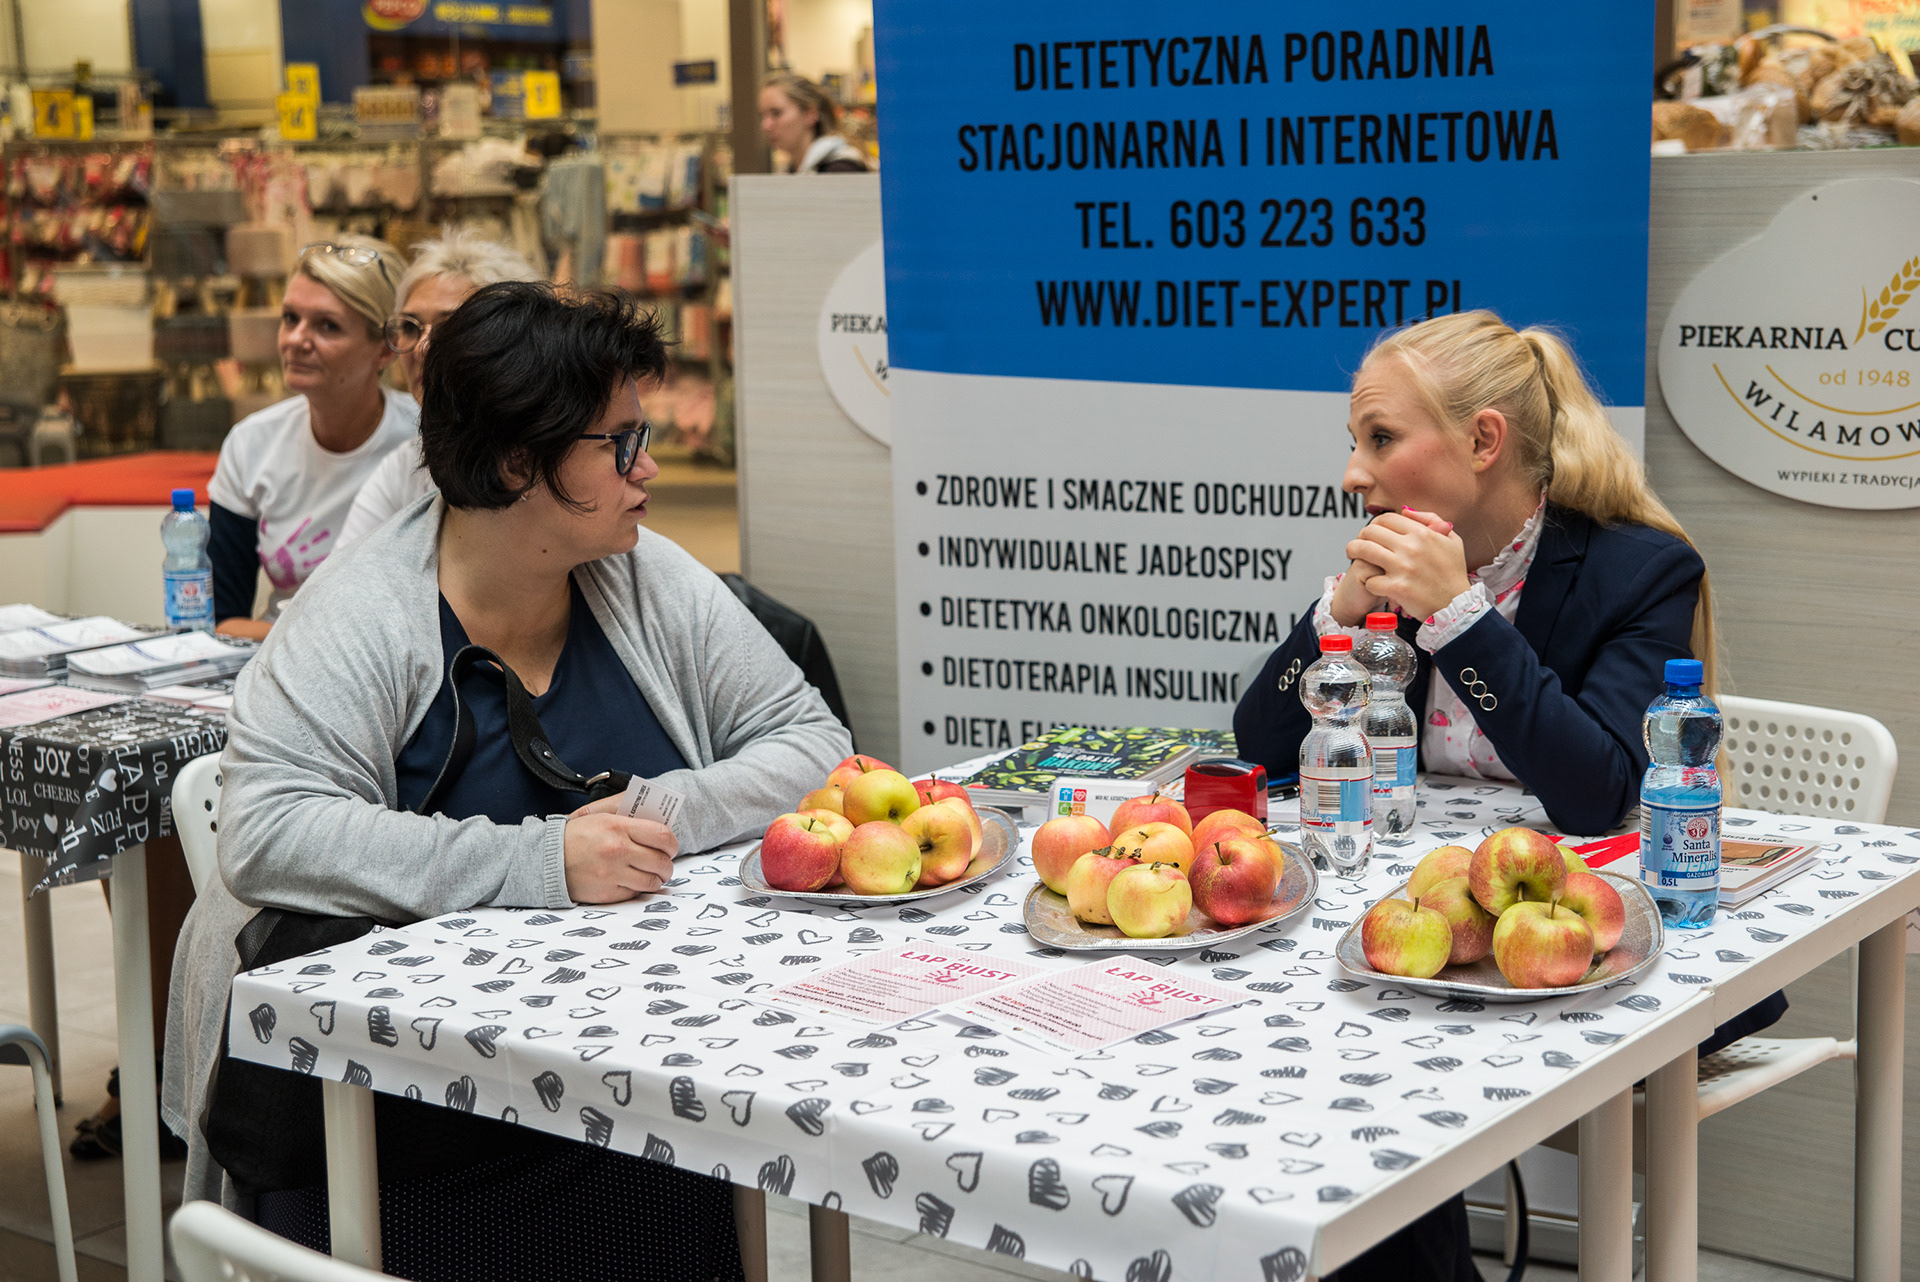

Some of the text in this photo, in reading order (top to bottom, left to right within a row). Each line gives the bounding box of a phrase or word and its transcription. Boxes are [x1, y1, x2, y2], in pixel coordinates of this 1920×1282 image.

[1013, 24, 1495, 91] DIETETYCZNA PORADNIA
[957, 108, 1560, 173] STACJONARNA I INTERNETOWA
[1074, 196, 1427, 249] TEL. 603 223 633
[1679, 325, 1848, 350] PIEKARNIA
[1819, 369, 1911, 388] od 1948
[1744, 380, 1920, 446] WILAMOW
[936, 474, 1038, 509] ZDROWE
[1047, 478, 1055, 509] I
[1063, 478, 1184, 514] SMACZNE
[1777, 470, 1836, 484] WYPIEKI
[1839, 473, 1849, 485] Z
[938, 535, 1292, 581] INDYWIDUALNE JADŁOSPISY
[940, 596, 1072, 633] DIETETYKA
[1081, 603, 1279, 643] ONKOLOGICZNA
[942, 655, 1117, 697] DIETOTERAPIA
[944, 715, 1011, 749] DIETA
[33, 745, 71, 778] JOY
[152, 750, 169, 787] LOL
[5, 786, 32, 807] LOL
[33, 781, 81, 805] CHEERS
[11, 808, 40, 839] Joy
[89, 807, 123, 837] FUN
[159, 794, 172, 838] SMILE
[1672, 850, 1718, 863] Mineralis
[1682, 839, 1711, 851] Santa
[900, 950, 948, 964] ŁAP
[943, 961, 1017, 981] BIUST
[1104, 966, 1154, 982] ŁAP
[1147, 983, 1223, 1006] BIUST
